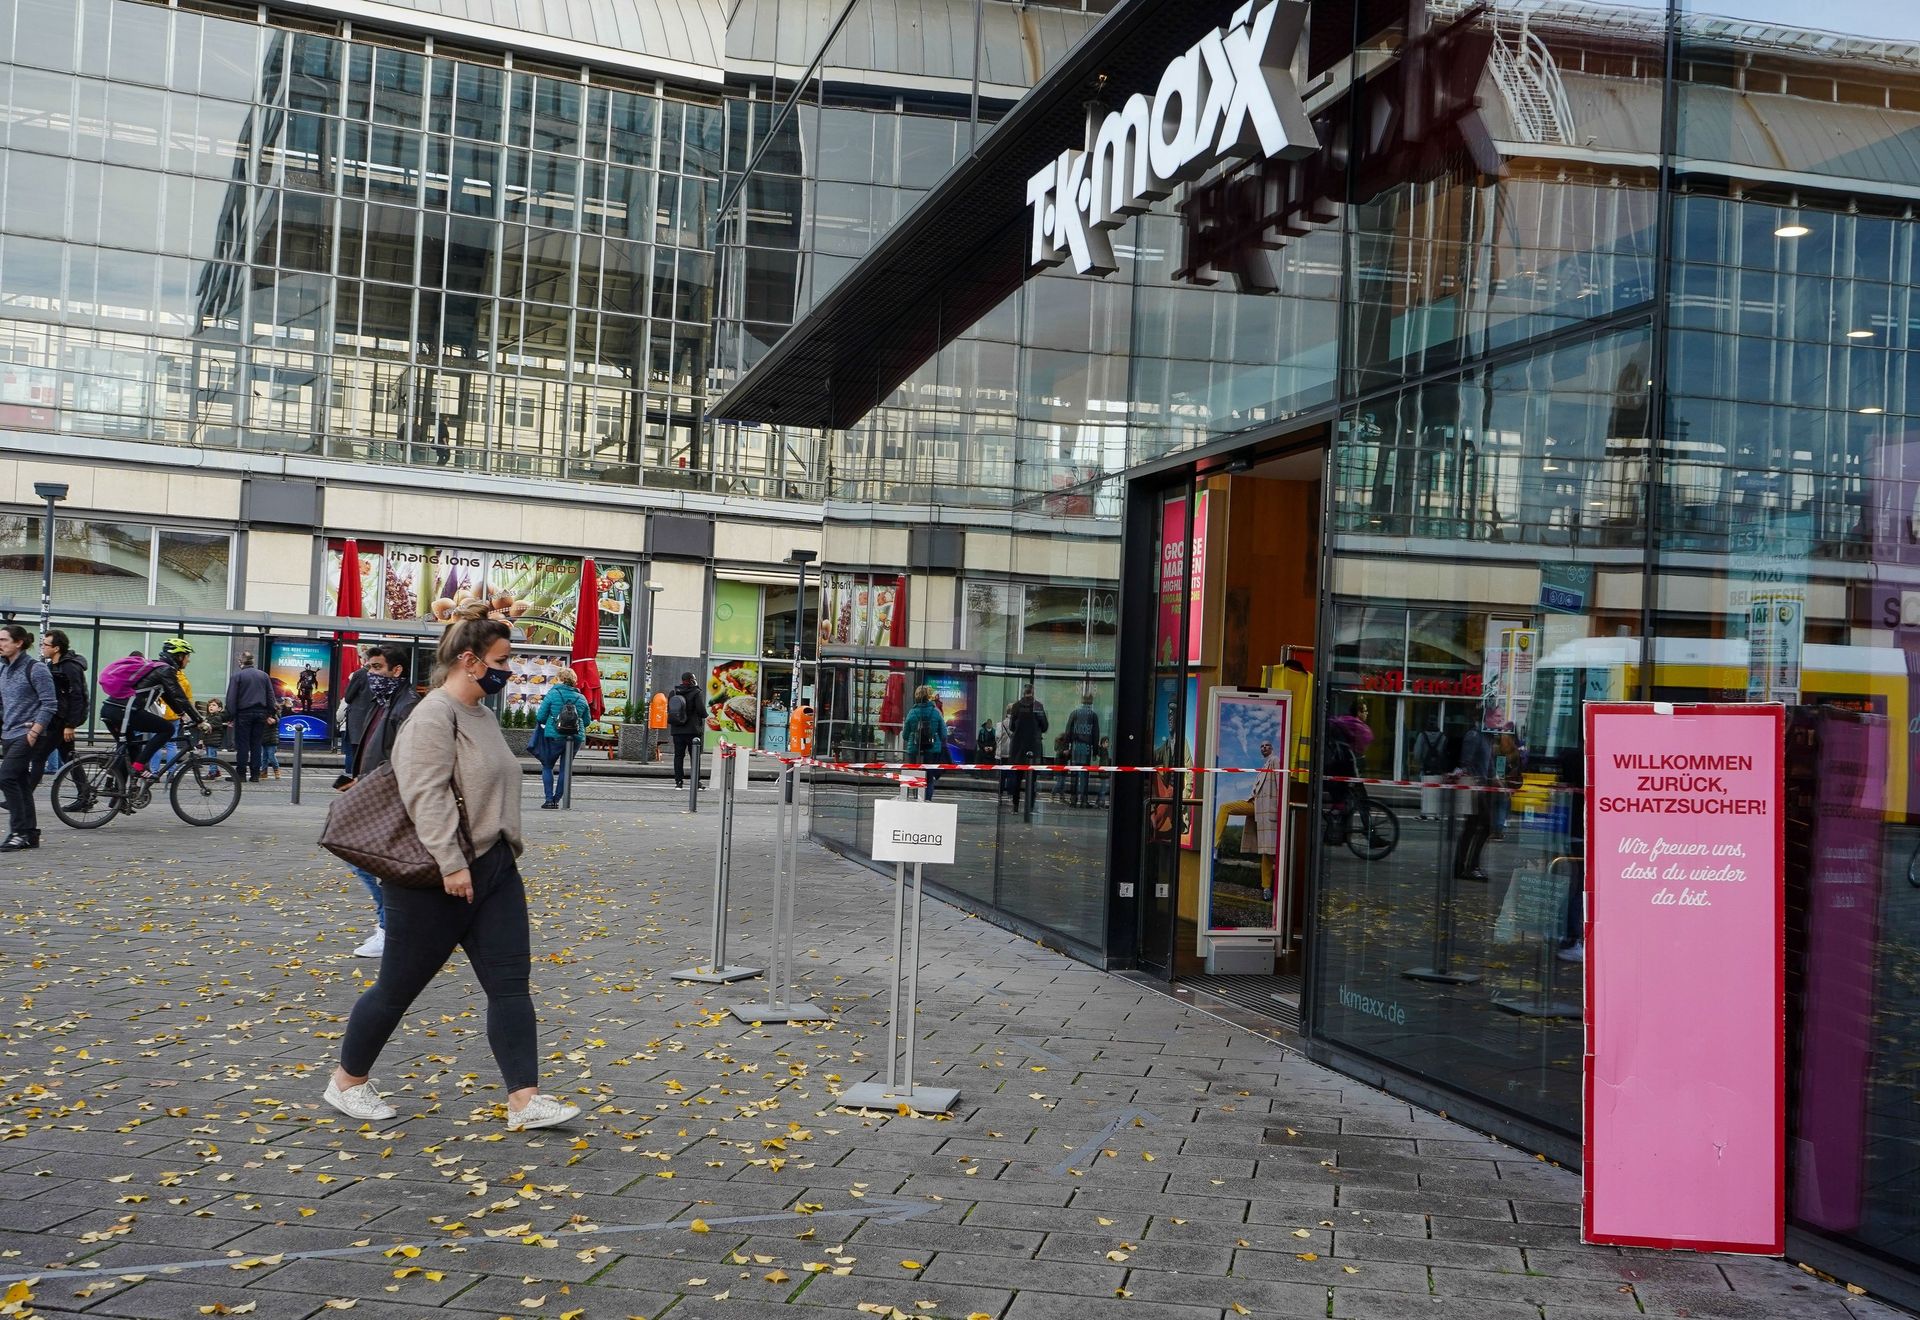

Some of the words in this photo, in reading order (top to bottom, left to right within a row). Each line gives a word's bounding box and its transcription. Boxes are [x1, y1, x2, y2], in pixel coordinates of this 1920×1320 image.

[1613, 753, 1752, 771] WILLKOMMEN
[1637, 773, 1728, 795] ZURÜCK,
[1599, 797, 1767, 815] SCHATZSUCHER!
[892, 829, 943, 846] Eingang
[1618, 837, 1651, 855] Wir
[1650, 837, 1710, 862] freuen
[1711, 844, 1747, 858] uns,
[1621, 862, 1658, 880] dass
[1661, 863, 1688, 881] du
[1689, 864, 1747, 882] wieder
[1651, 887, 1677, 905] da
[1678, 887, 1713, 906] bist.
[1338, 984, 1406, 1026] tkmaxx.de
